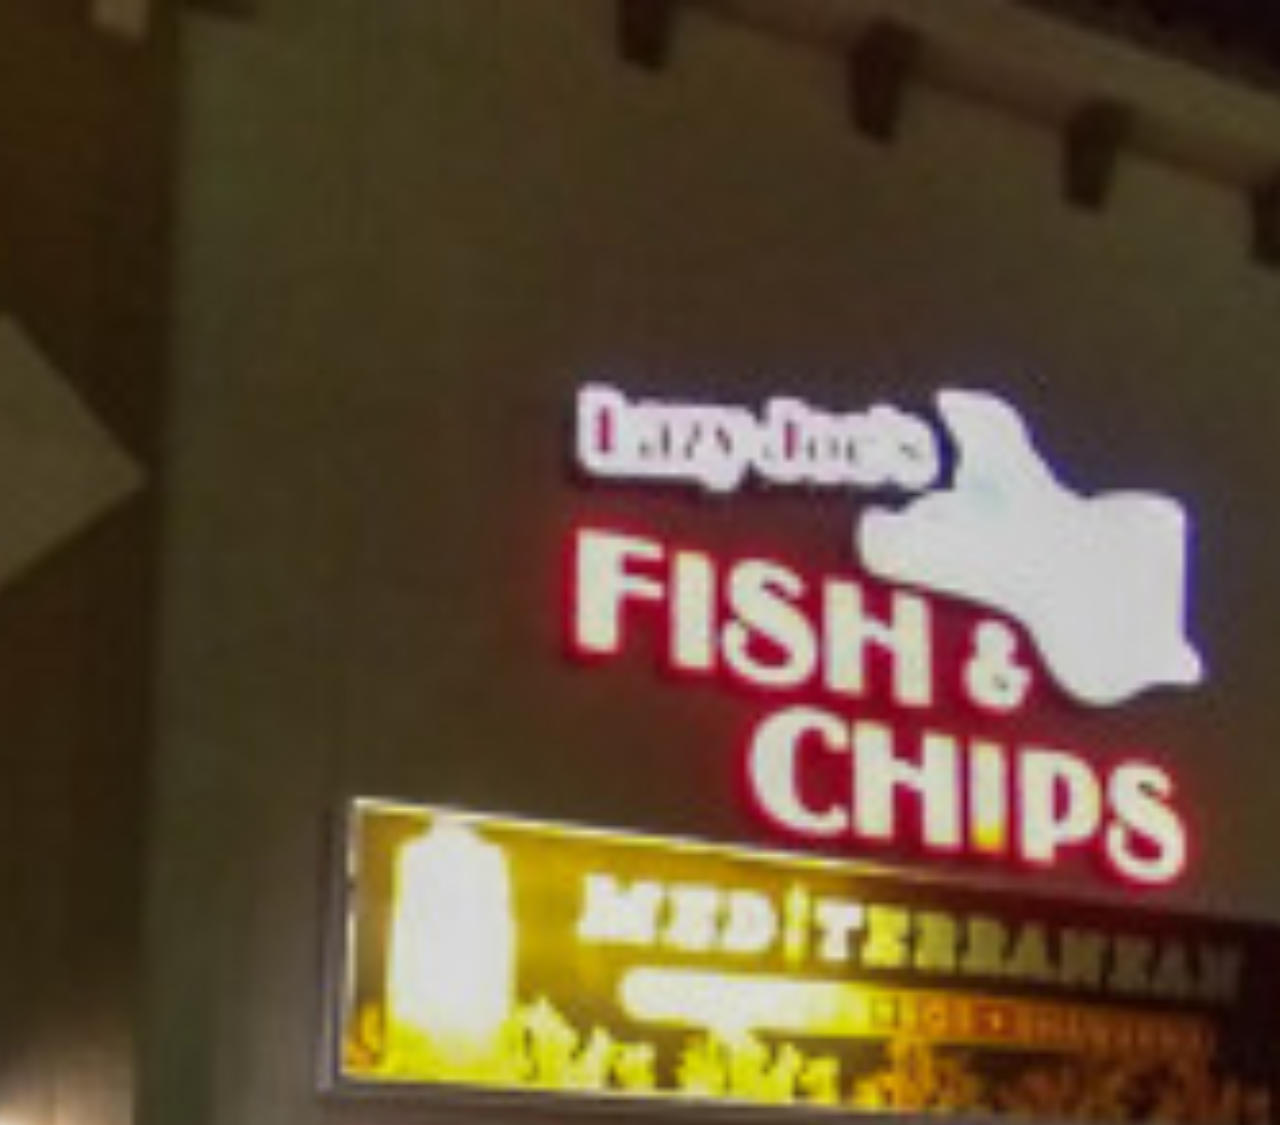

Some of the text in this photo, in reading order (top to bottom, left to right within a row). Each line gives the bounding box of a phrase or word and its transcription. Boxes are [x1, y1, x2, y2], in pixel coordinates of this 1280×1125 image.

[575, 528, 1032, 714] FISH &
[748, 705, 1188, 884] CHIPS
[576, 870, 1250, 998] MEDITERRANEAN
